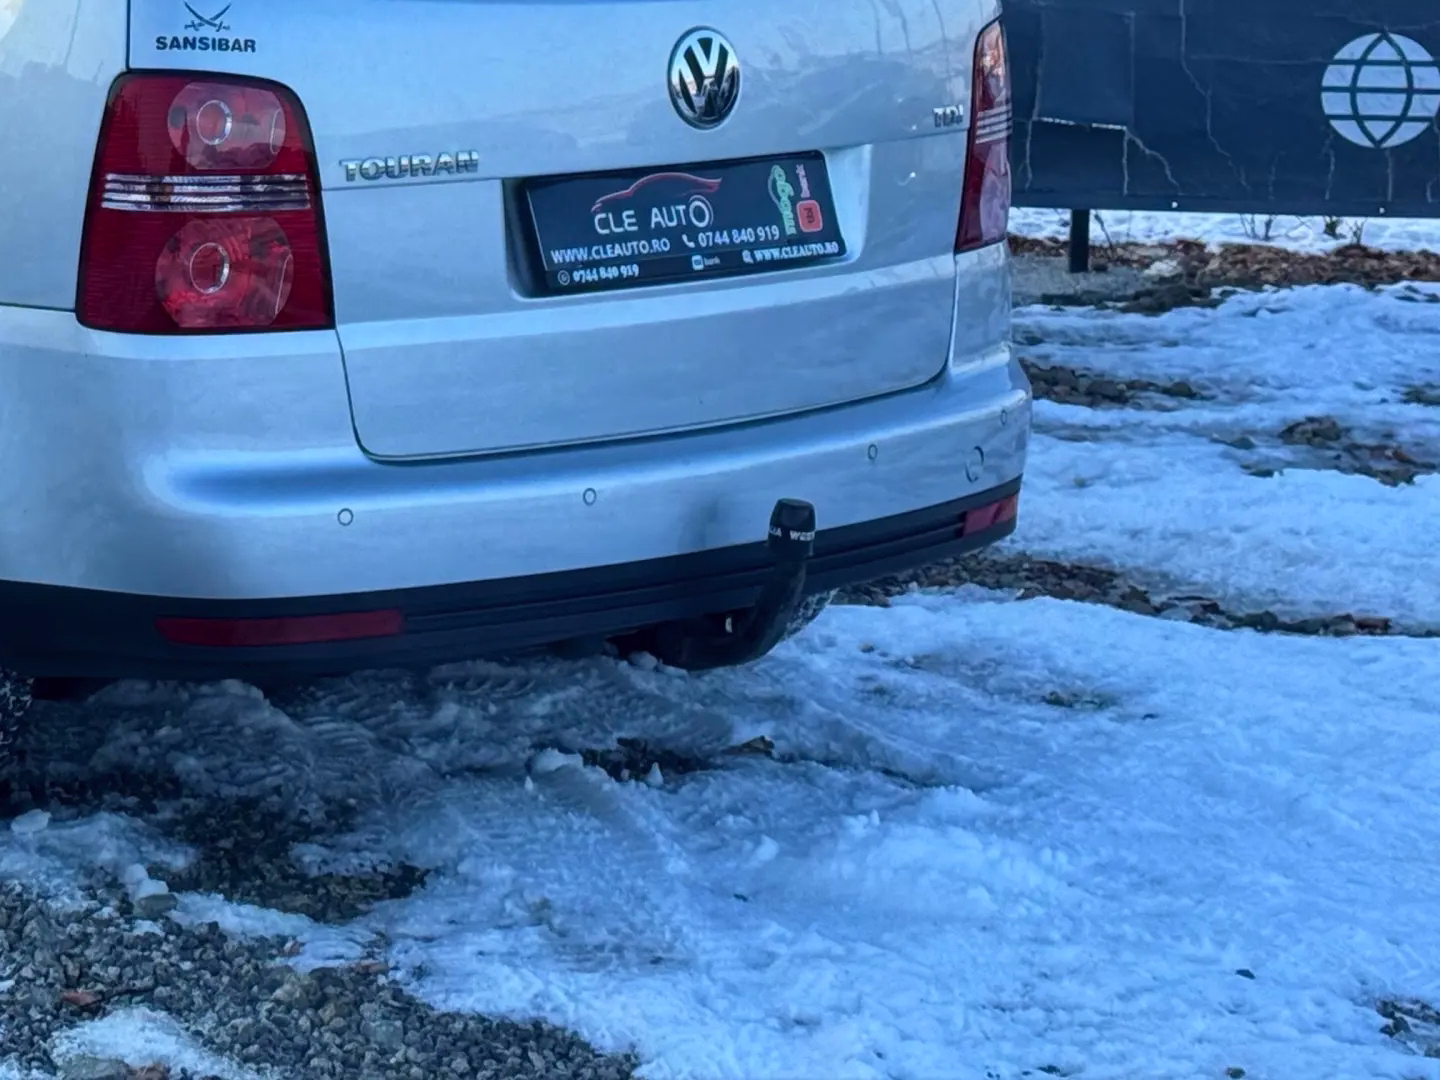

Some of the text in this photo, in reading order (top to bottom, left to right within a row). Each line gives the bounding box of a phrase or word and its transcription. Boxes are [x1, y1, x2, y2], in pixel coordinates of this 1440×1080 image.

[155, 35, 257, 53] SANSIBAR
[339, 150, 479, 182] TOURAN
[594, 199, 711, 235] CLE AUTO
[550, 237, 671, 264] WWW.CLEAUTO.RO
[698, 231, 730, 248] 0744
[732, 228, 756, 244] 840
[756, 224, 780, 241] 919
